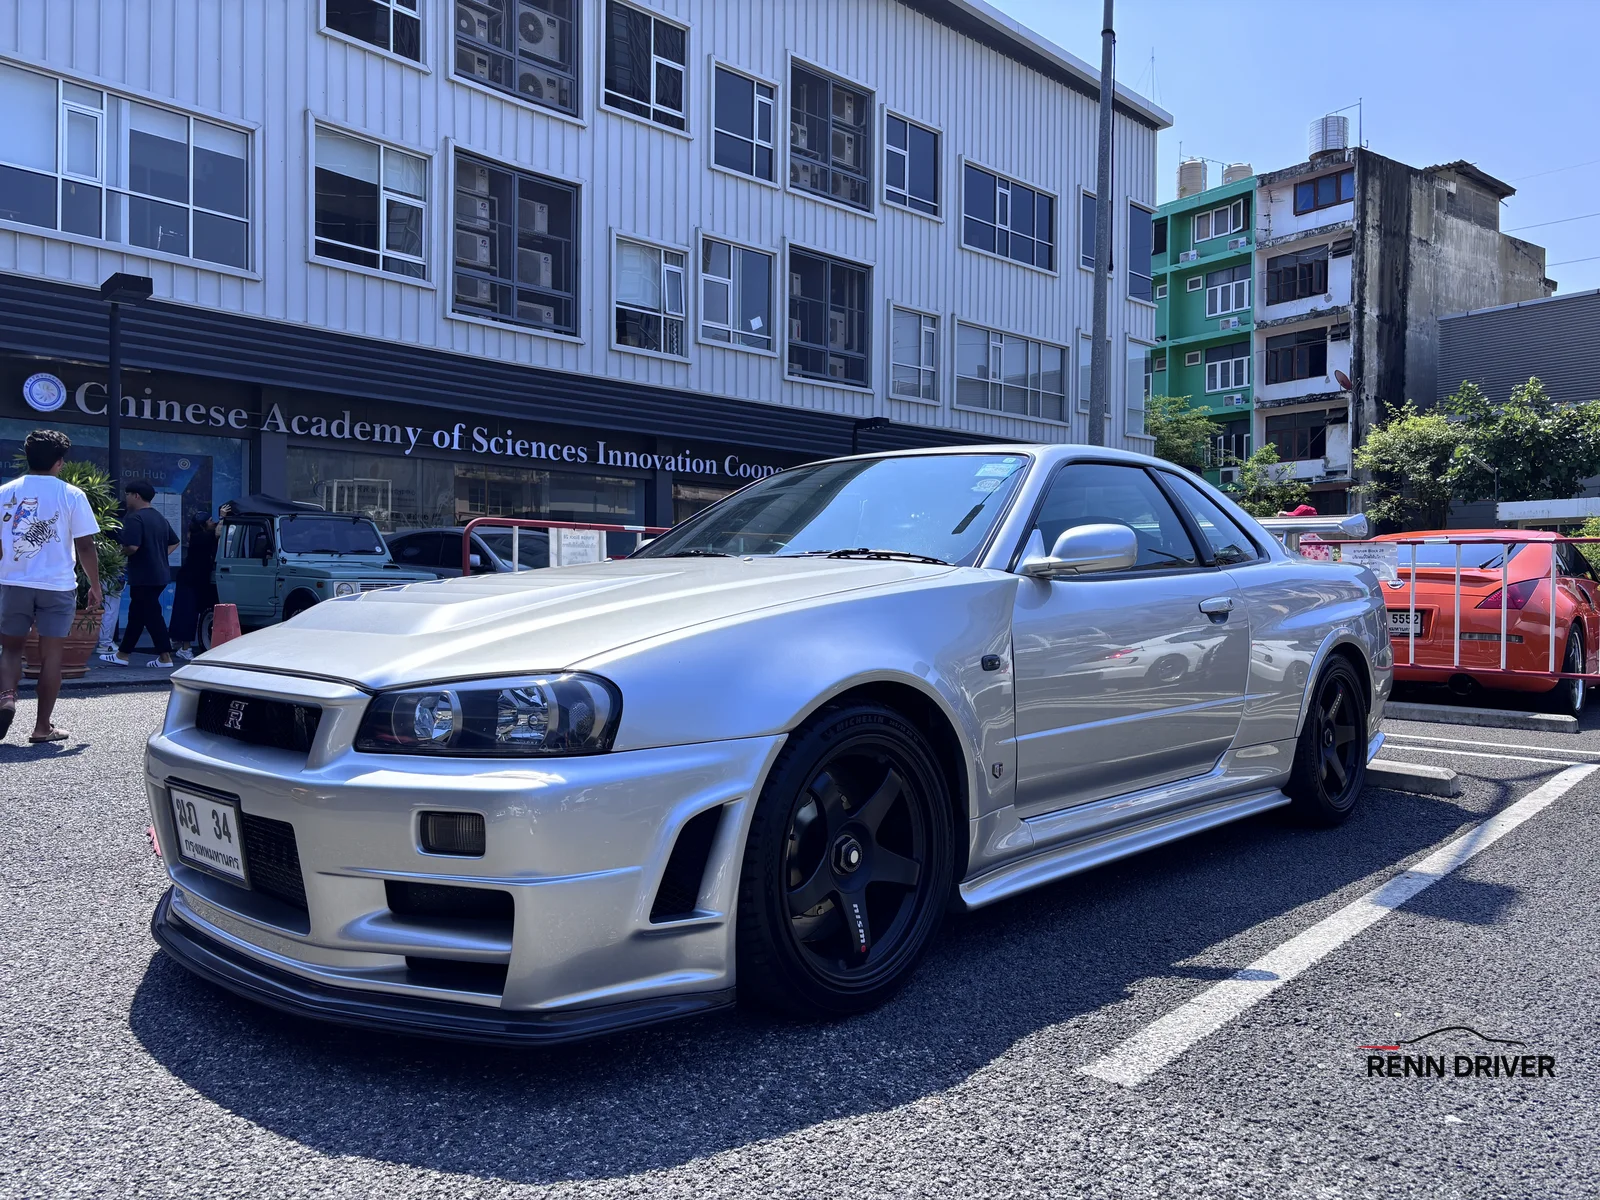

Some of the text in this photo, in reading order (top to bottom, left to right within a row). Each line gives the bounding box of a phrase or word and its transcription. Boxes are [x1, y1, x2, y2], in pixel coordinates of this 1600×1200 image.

[75, 381, 248, 429] Chinese
[260, 403, 422, 455] Academy
[432, 422, 466, 450] of
[472, 426, 588, 463] Sciences
[596, 440, 718, 475] Innovation
[143, 468, 166, 480] Hub
[1392, 613, 1419, 625] 5552
[836, 715, 885, 732] MICHELIN
[211, 809, 232, 844] 34
[185, 839, 240, 870] กรุงเทพมหานคร
